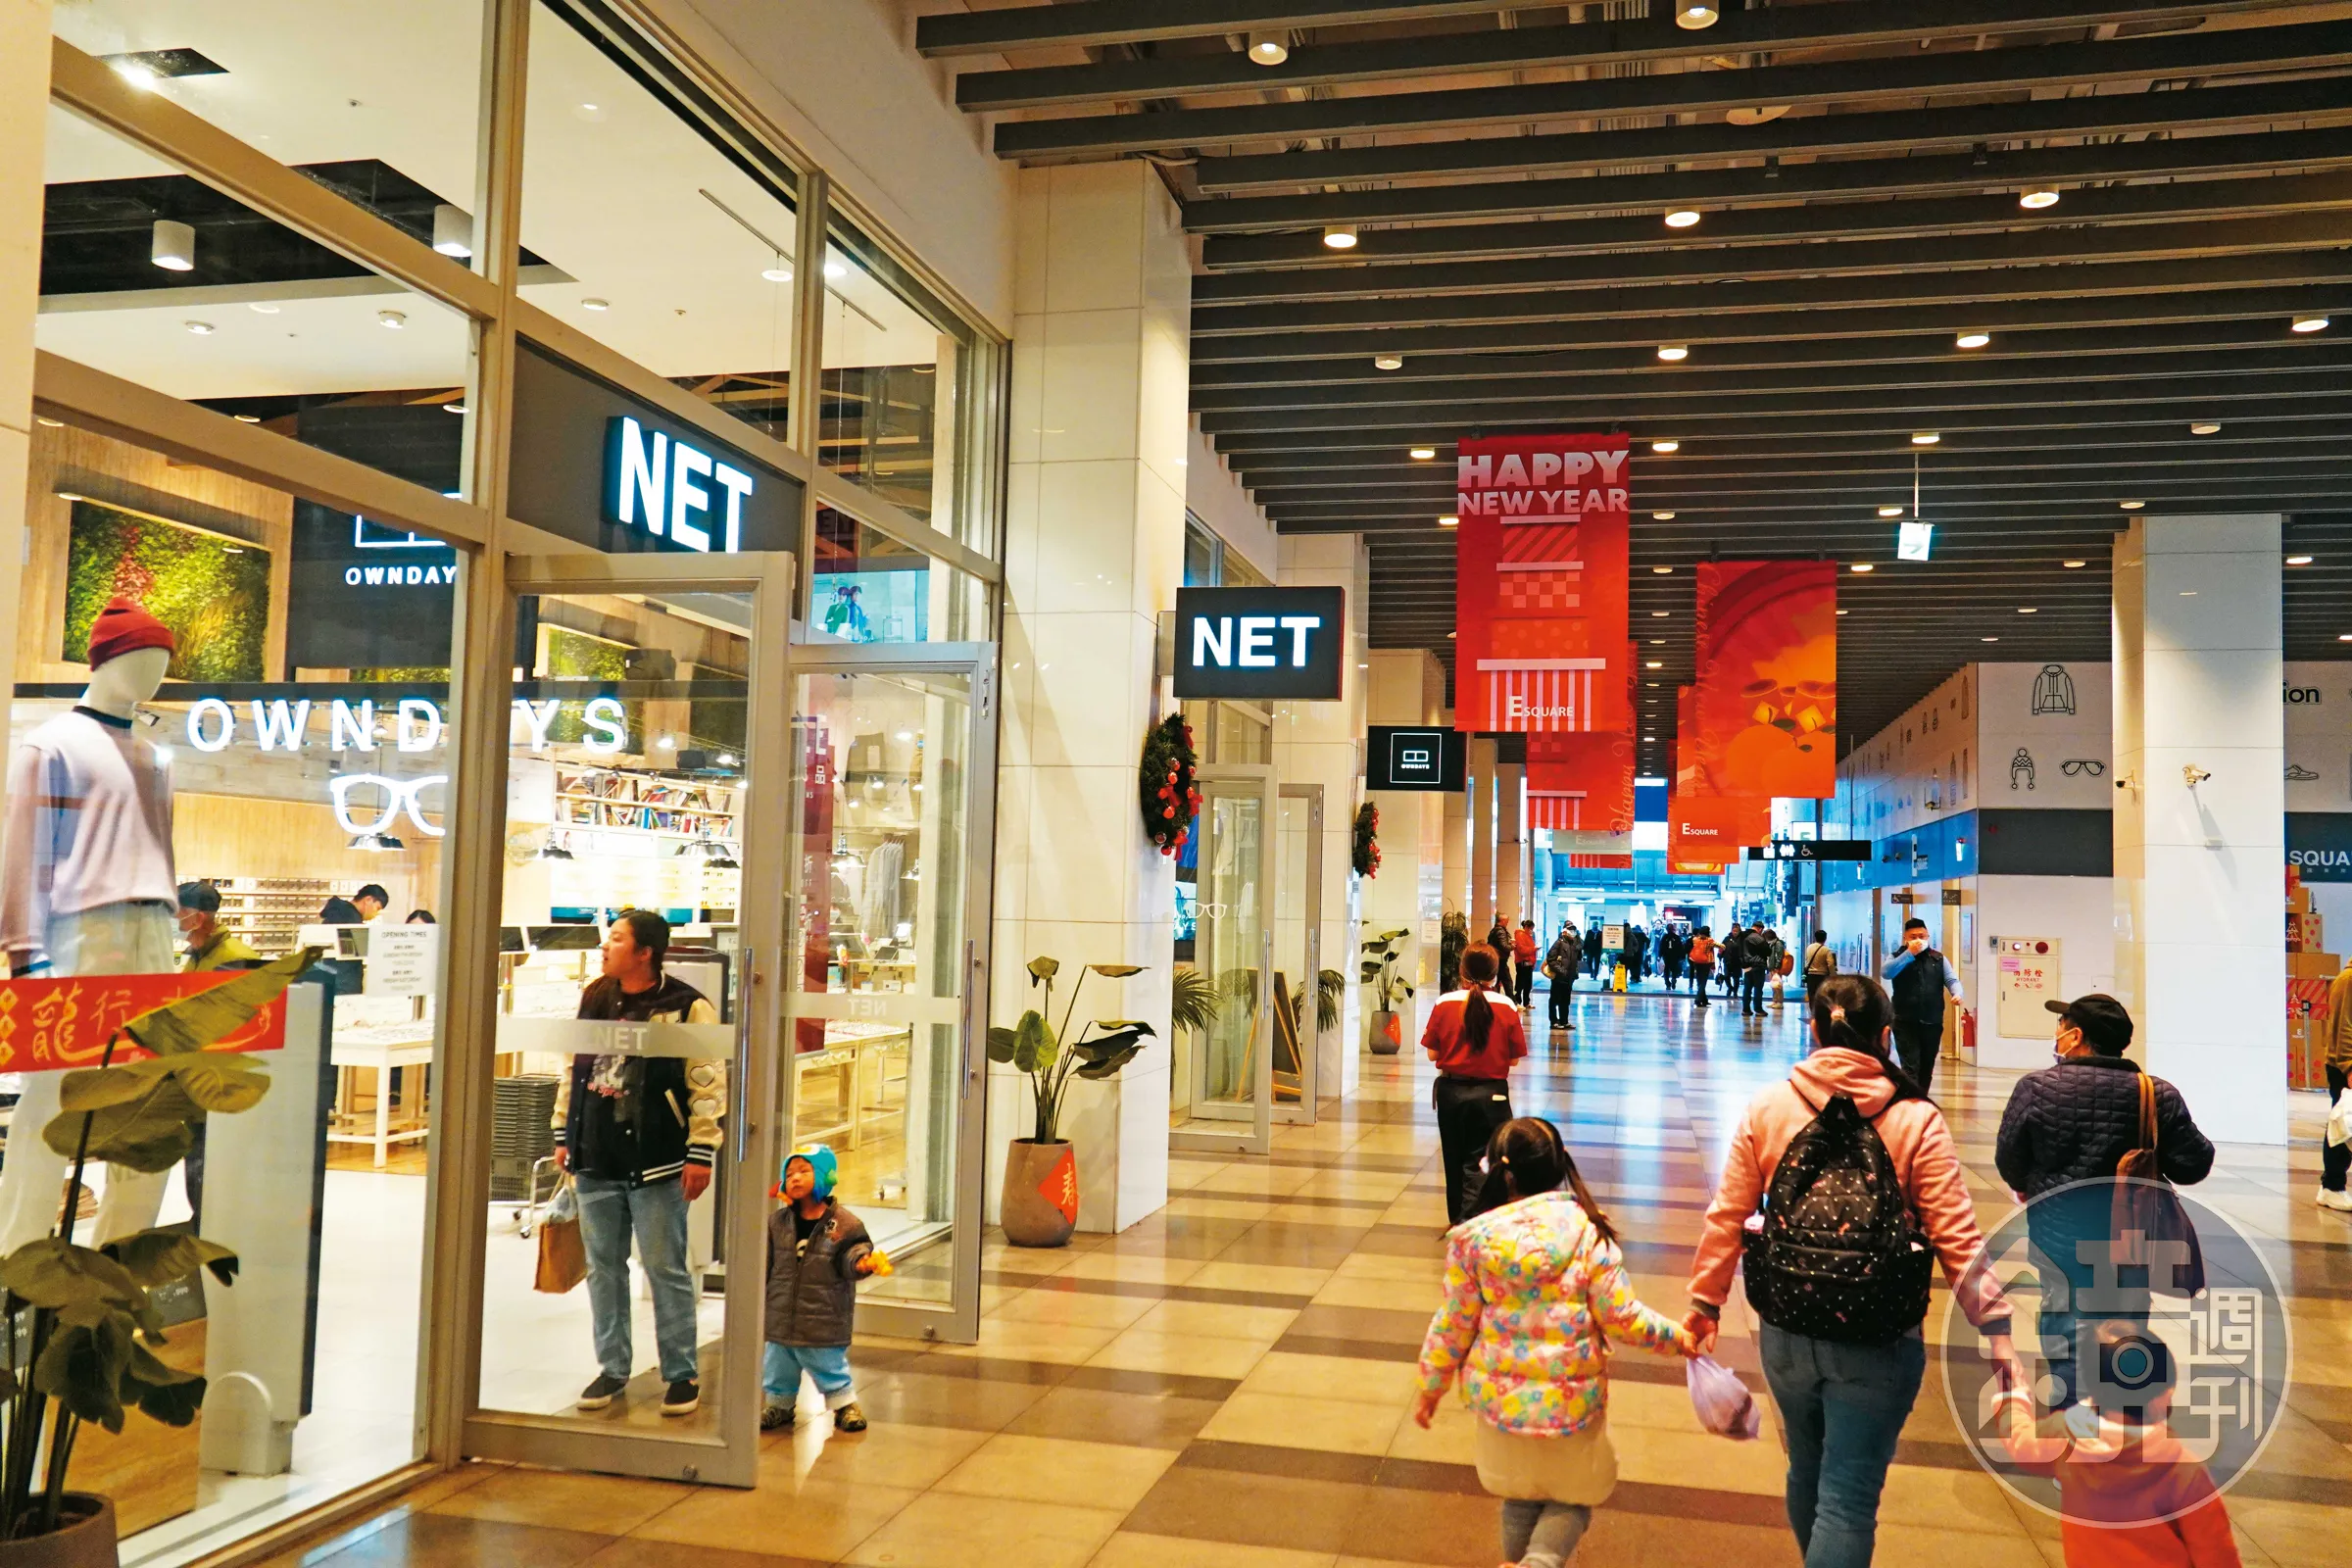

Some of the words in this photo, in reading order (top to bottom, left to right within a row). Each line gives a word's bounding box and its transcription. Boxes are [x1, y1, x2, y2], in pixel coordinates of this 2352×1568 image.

[619, 416, 753, 554] NET
[1458, 450, 1629, 488] HAPPY
[1458, 491, 1534, 515] NEW
[1540, 489, 1629, 514] YEAR
[1193, 616, 1320, 666] NET
[186, 698, 626, 754] OWNDYS
[2289, 850, 2352, 866] SQUA
[595, 1026, 648, 1051] NET
